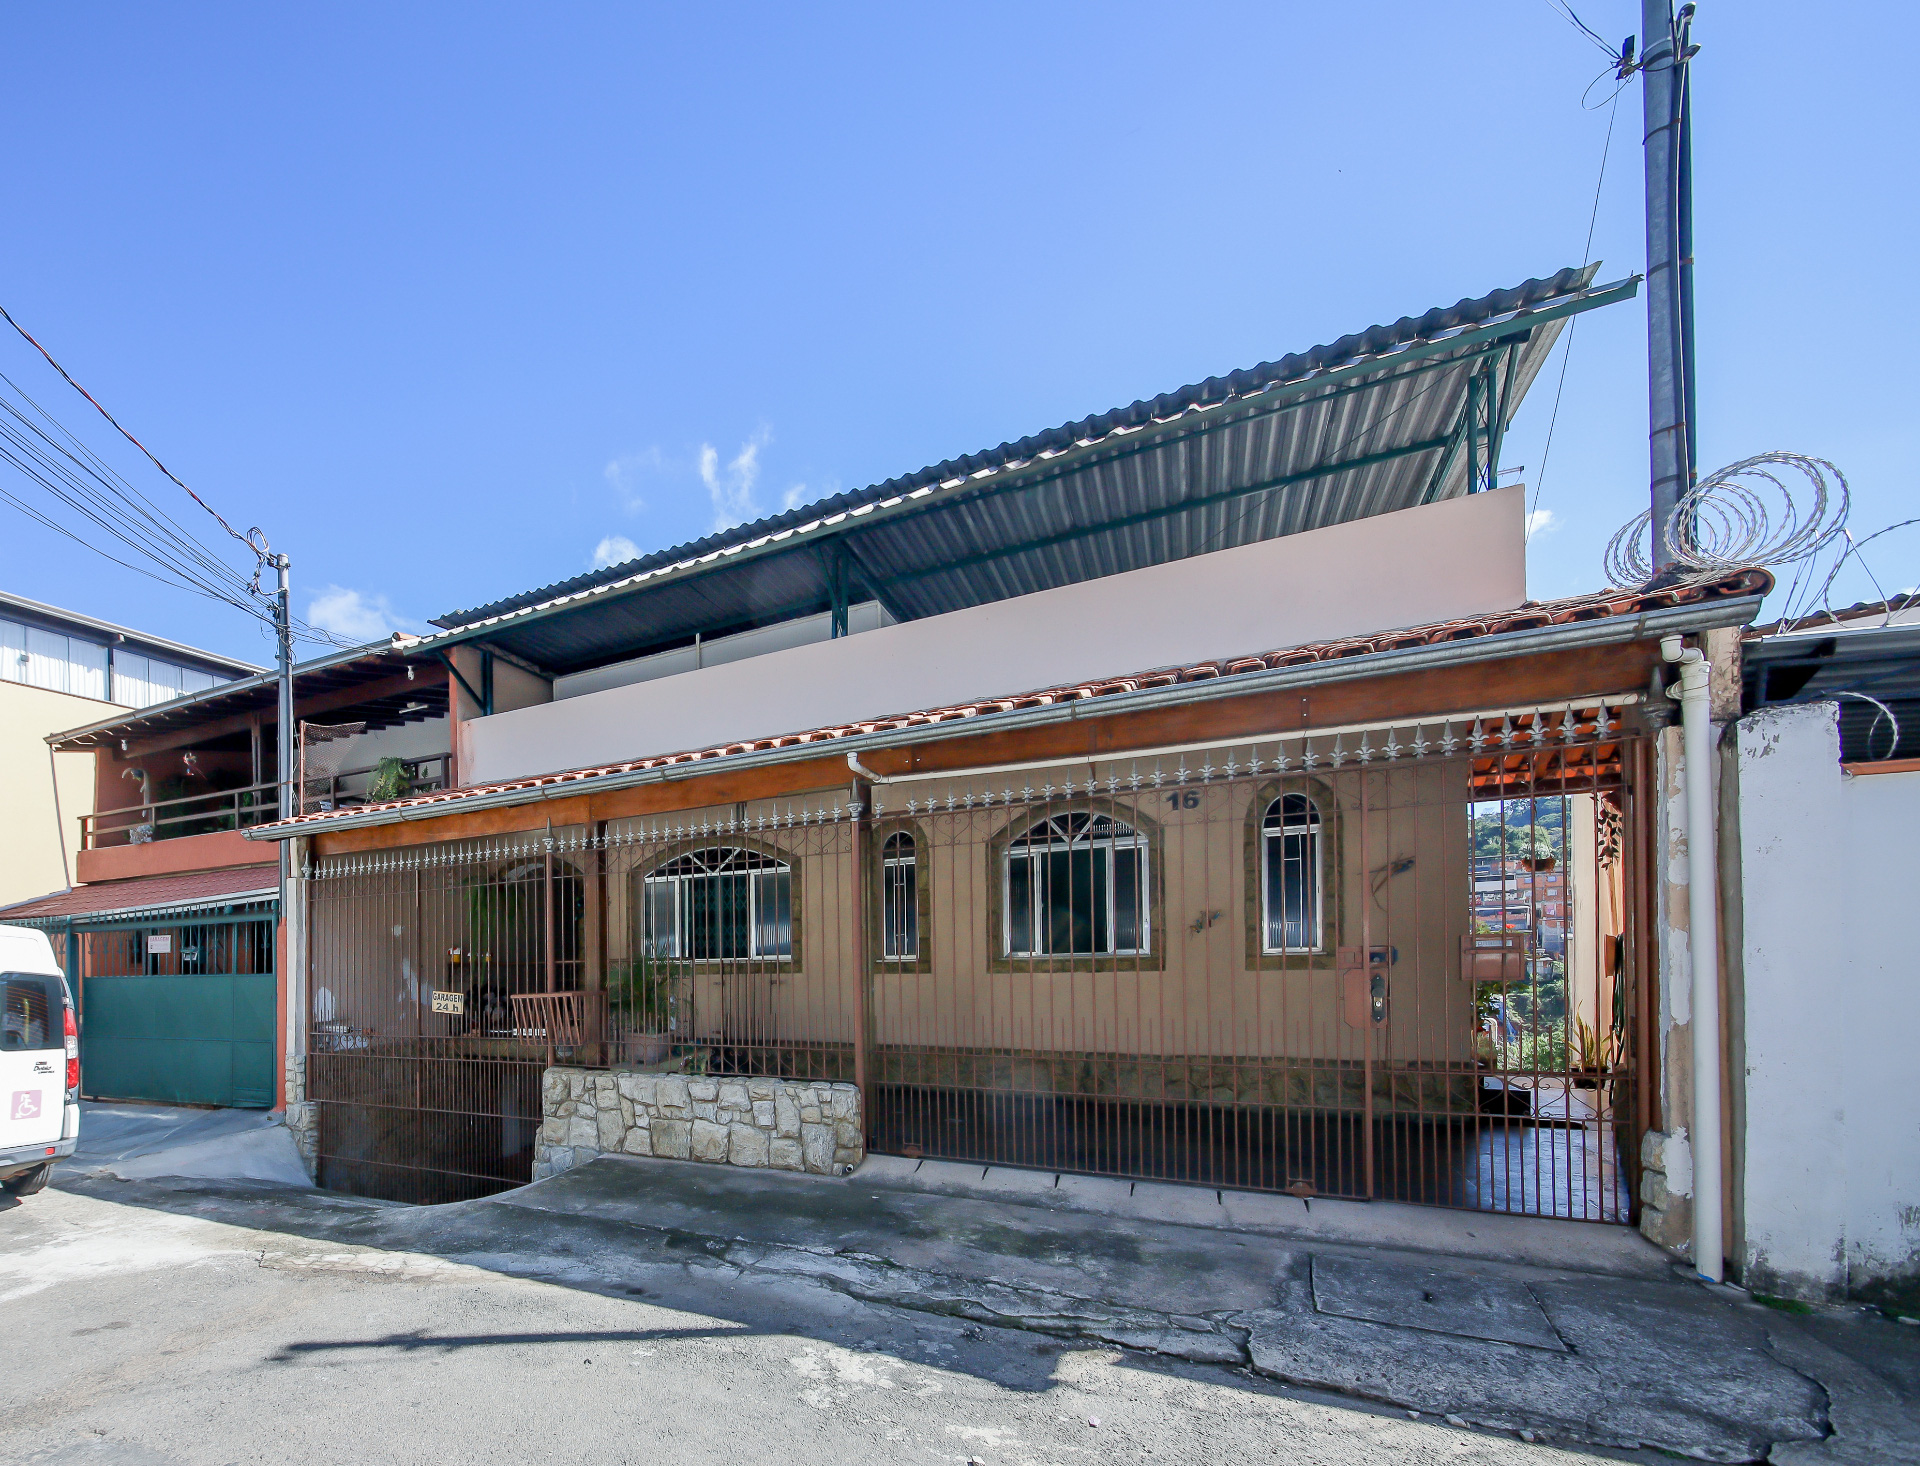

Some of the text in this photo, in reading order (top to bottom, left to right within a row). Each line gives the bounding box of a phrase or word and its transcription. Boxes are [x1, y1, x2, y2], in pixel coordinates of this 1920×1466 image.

[1165, 789, 1200, 811] 16
[436, 1002, 459, 1012] 24 h
